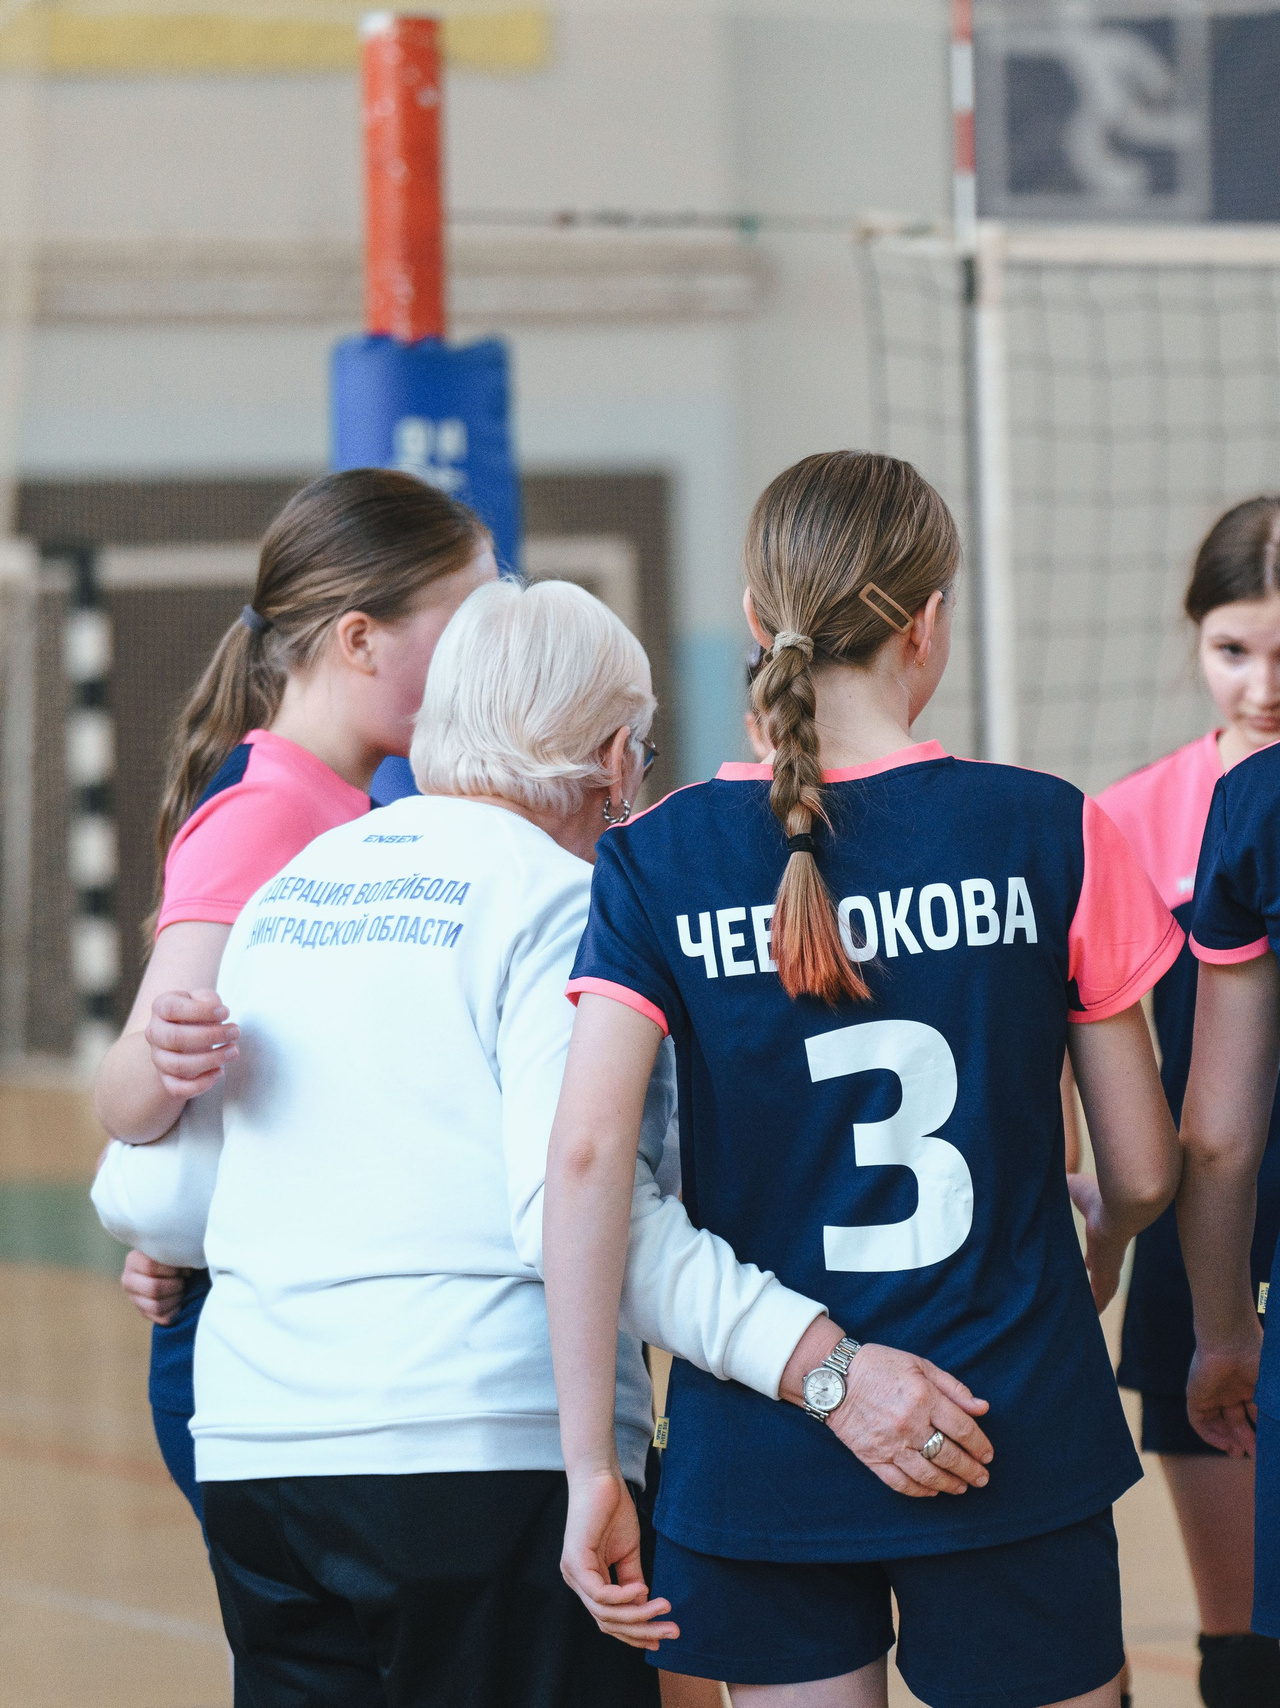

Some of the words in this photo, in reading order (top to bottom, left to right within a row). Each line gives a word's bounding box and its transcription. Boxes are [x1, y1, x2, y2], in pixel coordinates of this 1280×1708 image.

[258, 876, 356, 908] ДЕРАЦИЯ
[352, 873, 471, 906] ВОЛЕЙБОЛА
[366, 915, 464, 949] ОБЛАСТИ
[804, 1019, 974, 1272] 3
